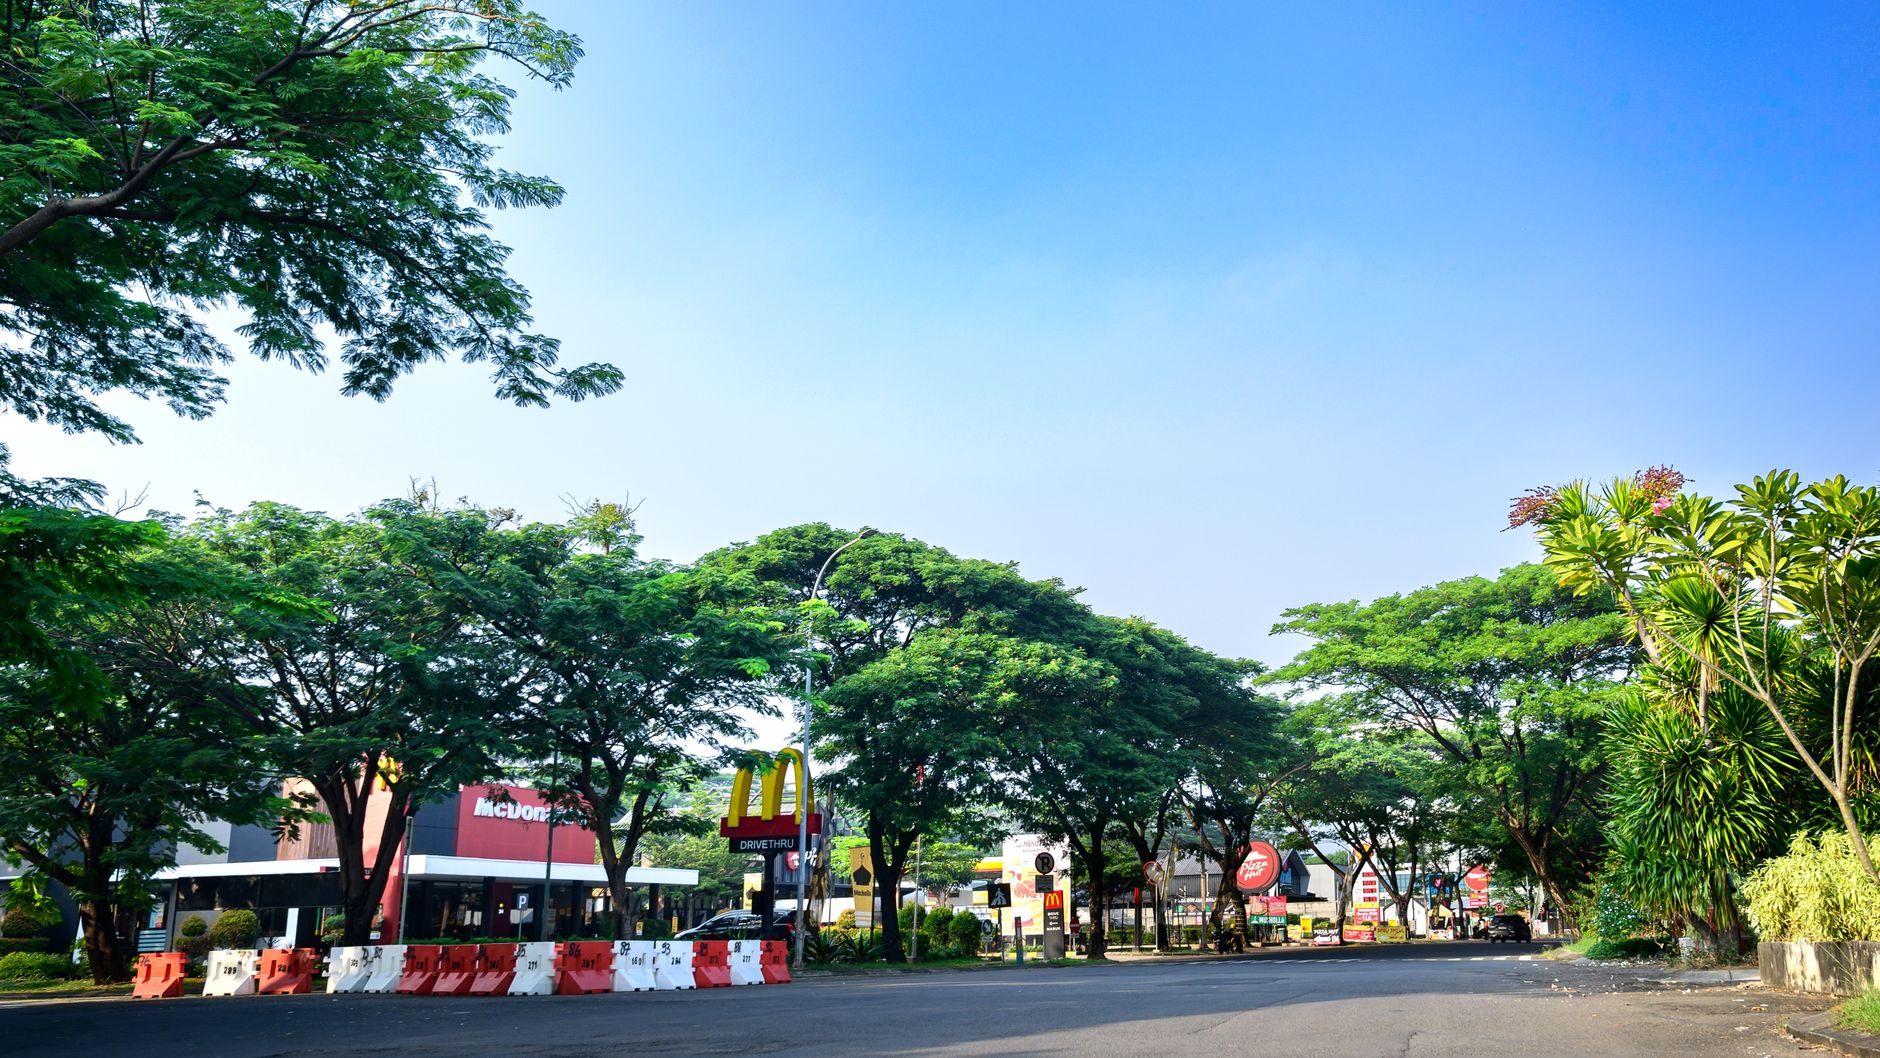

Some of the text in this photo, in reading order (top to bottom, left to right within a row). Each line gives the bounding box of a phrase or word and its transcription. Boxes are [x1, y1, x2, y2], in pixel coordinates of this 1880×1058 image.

[1239, 860, 1269, 876] Pizza
[1244, 867, 1266, 881] Hut
[518, 895, 527, 909] P
[620, 941, 631, 956] 87
[661, 942, 671, 955] 93
